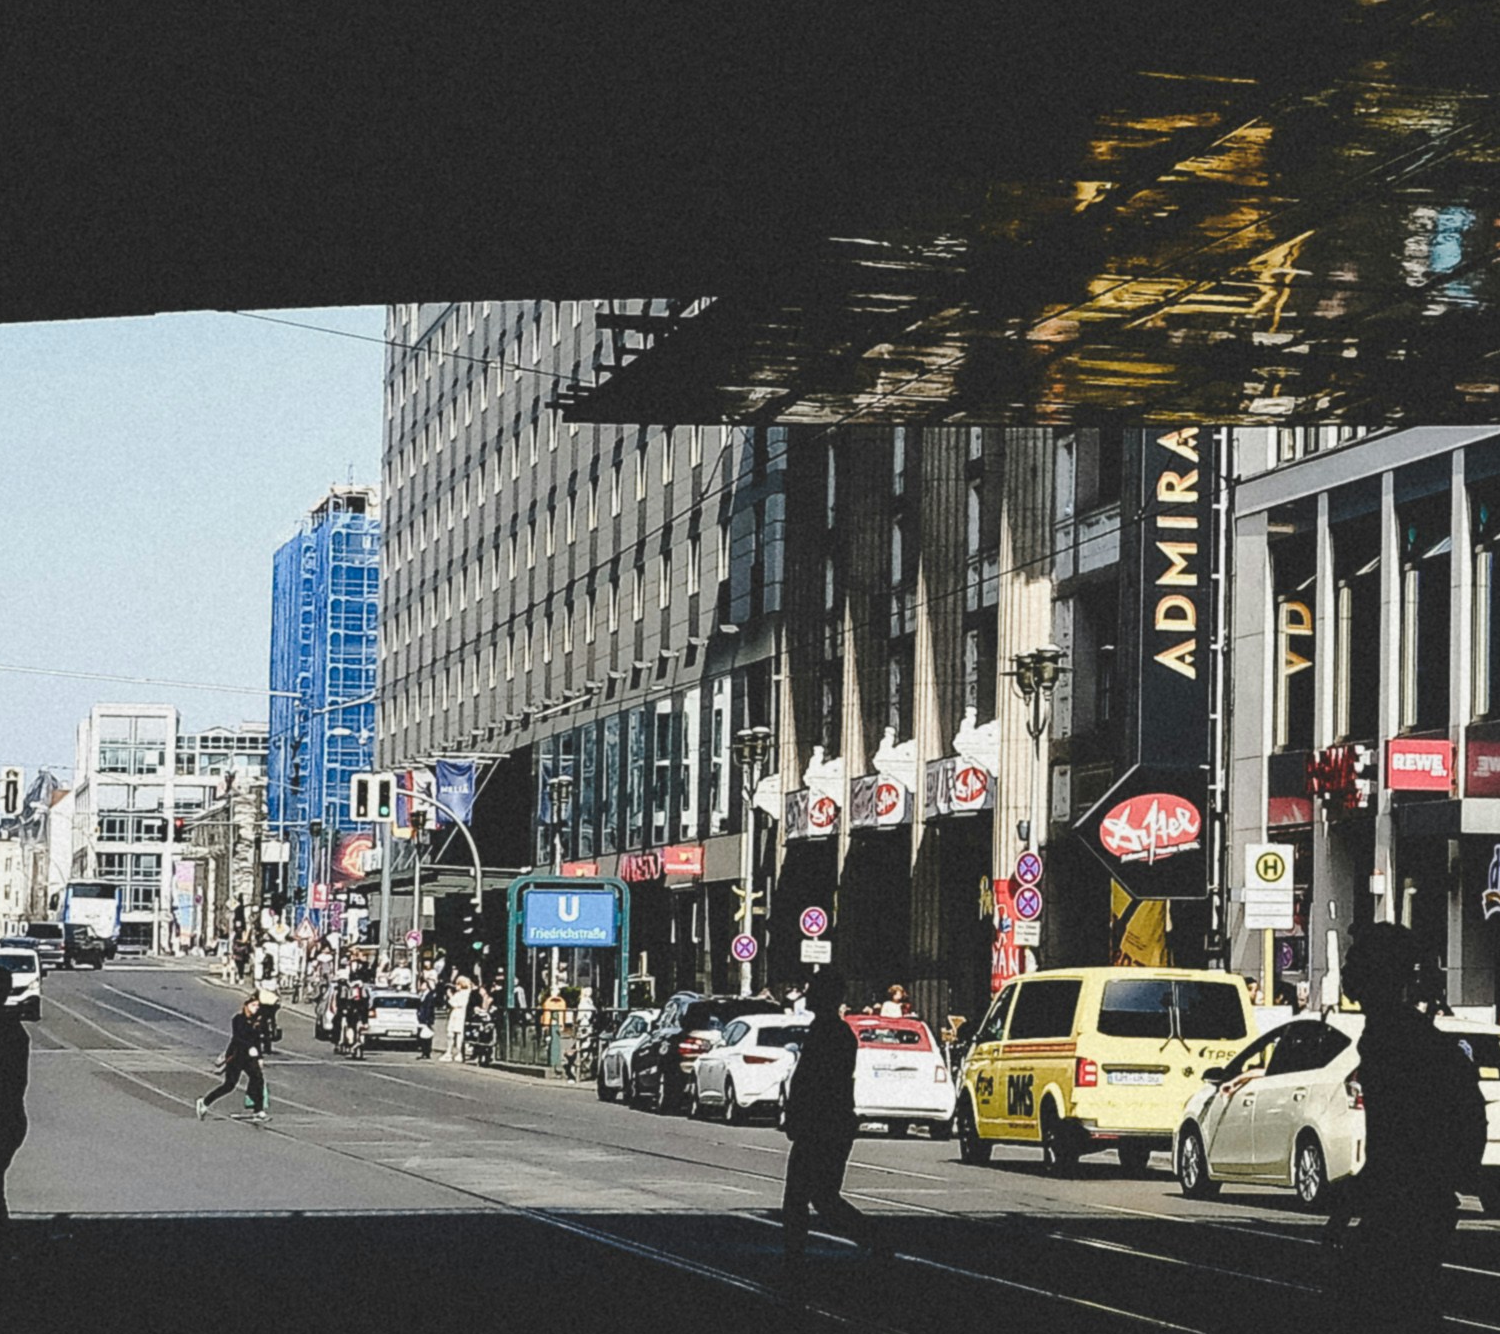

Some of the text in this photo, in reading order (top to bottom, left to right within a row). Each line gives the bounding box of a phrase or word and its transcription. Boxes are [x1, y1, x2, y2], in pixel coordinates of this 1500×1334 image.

[1392, 753, 1444, 771] REWE
[1263, 858, 1278, 876] H
[558, 895, 580, 922] U
[529, 927, 607, 940] Friedrichstraße
